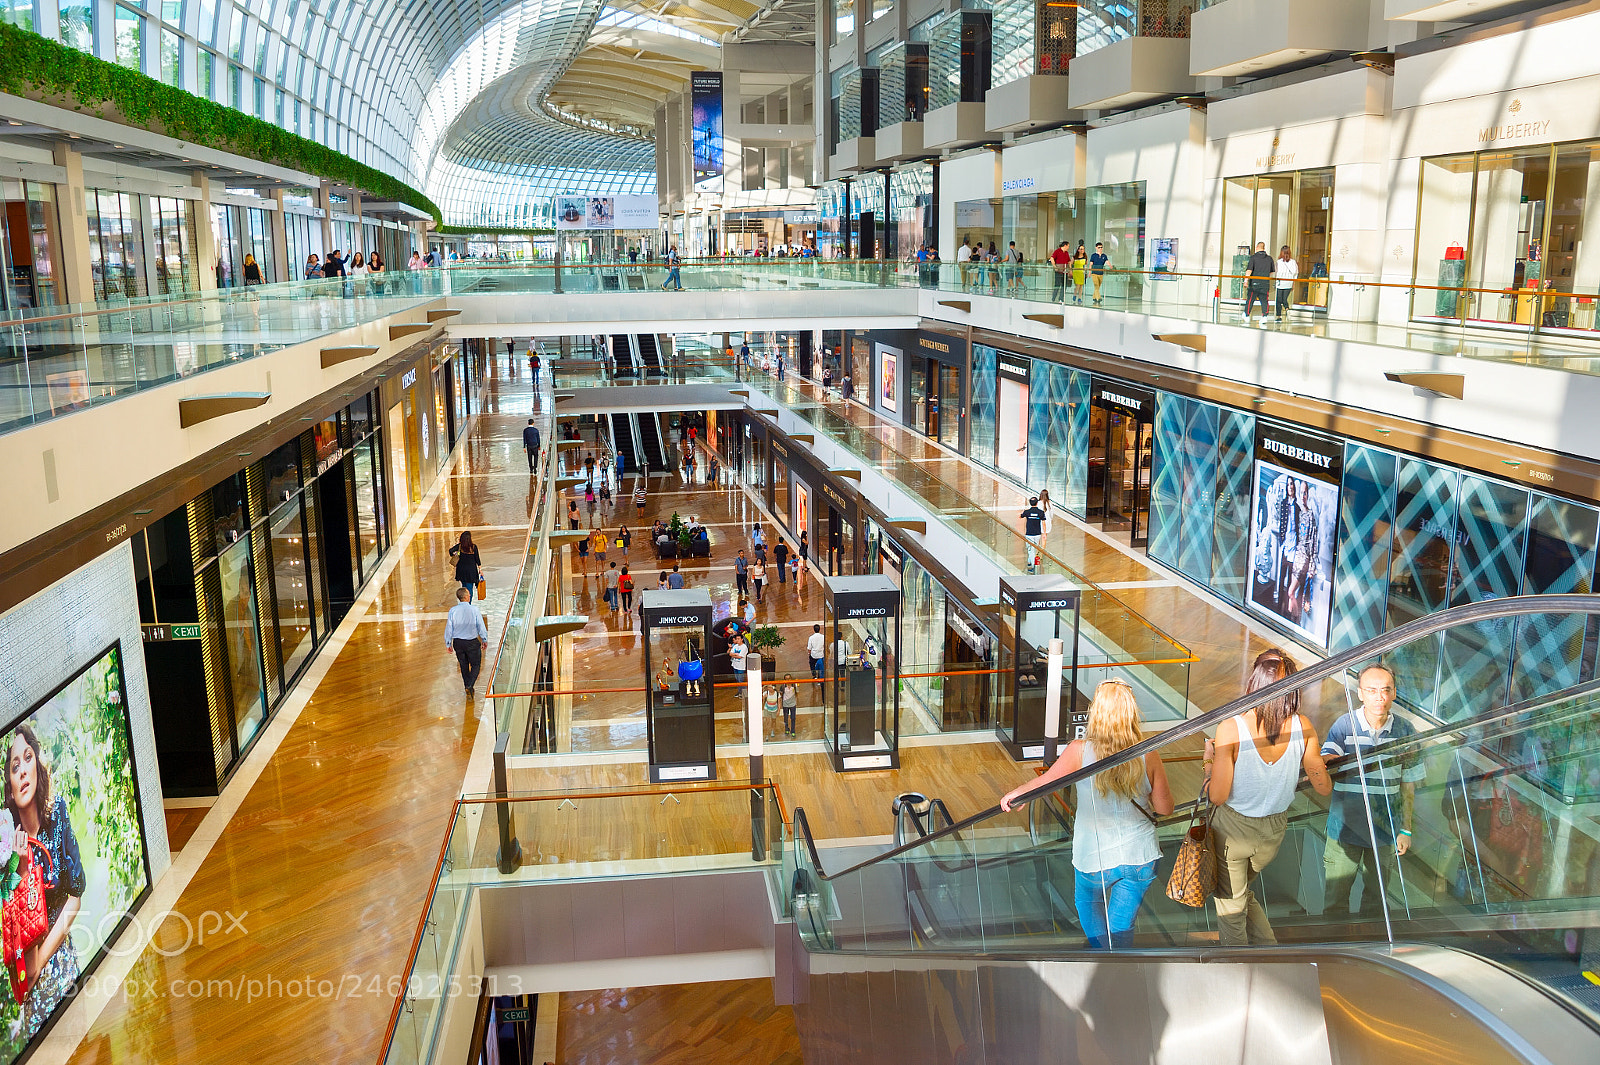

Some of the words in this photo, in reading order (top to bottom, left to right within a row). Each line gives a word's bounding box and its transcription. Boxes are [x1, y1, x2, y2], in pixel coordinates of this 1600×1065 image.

[1478, 119, 1551, 142] MULBERRY
[1256, 153, 1296, 168] MULBERRY
[1003, 177, 1035, 190] BALENCIAGA
[1101, 390, 1142, 410] BURBERRY
[1263, 437, 1333, 469] BURBERRY
[659, 616, 677, 624] JIMMY
[677, 615, 699, 623] CHOO
[180, 626, 199, 637] EXIT
[1072, 714, 1089, 722] LEV
[510, 1010, 527, 1020] EXIT
